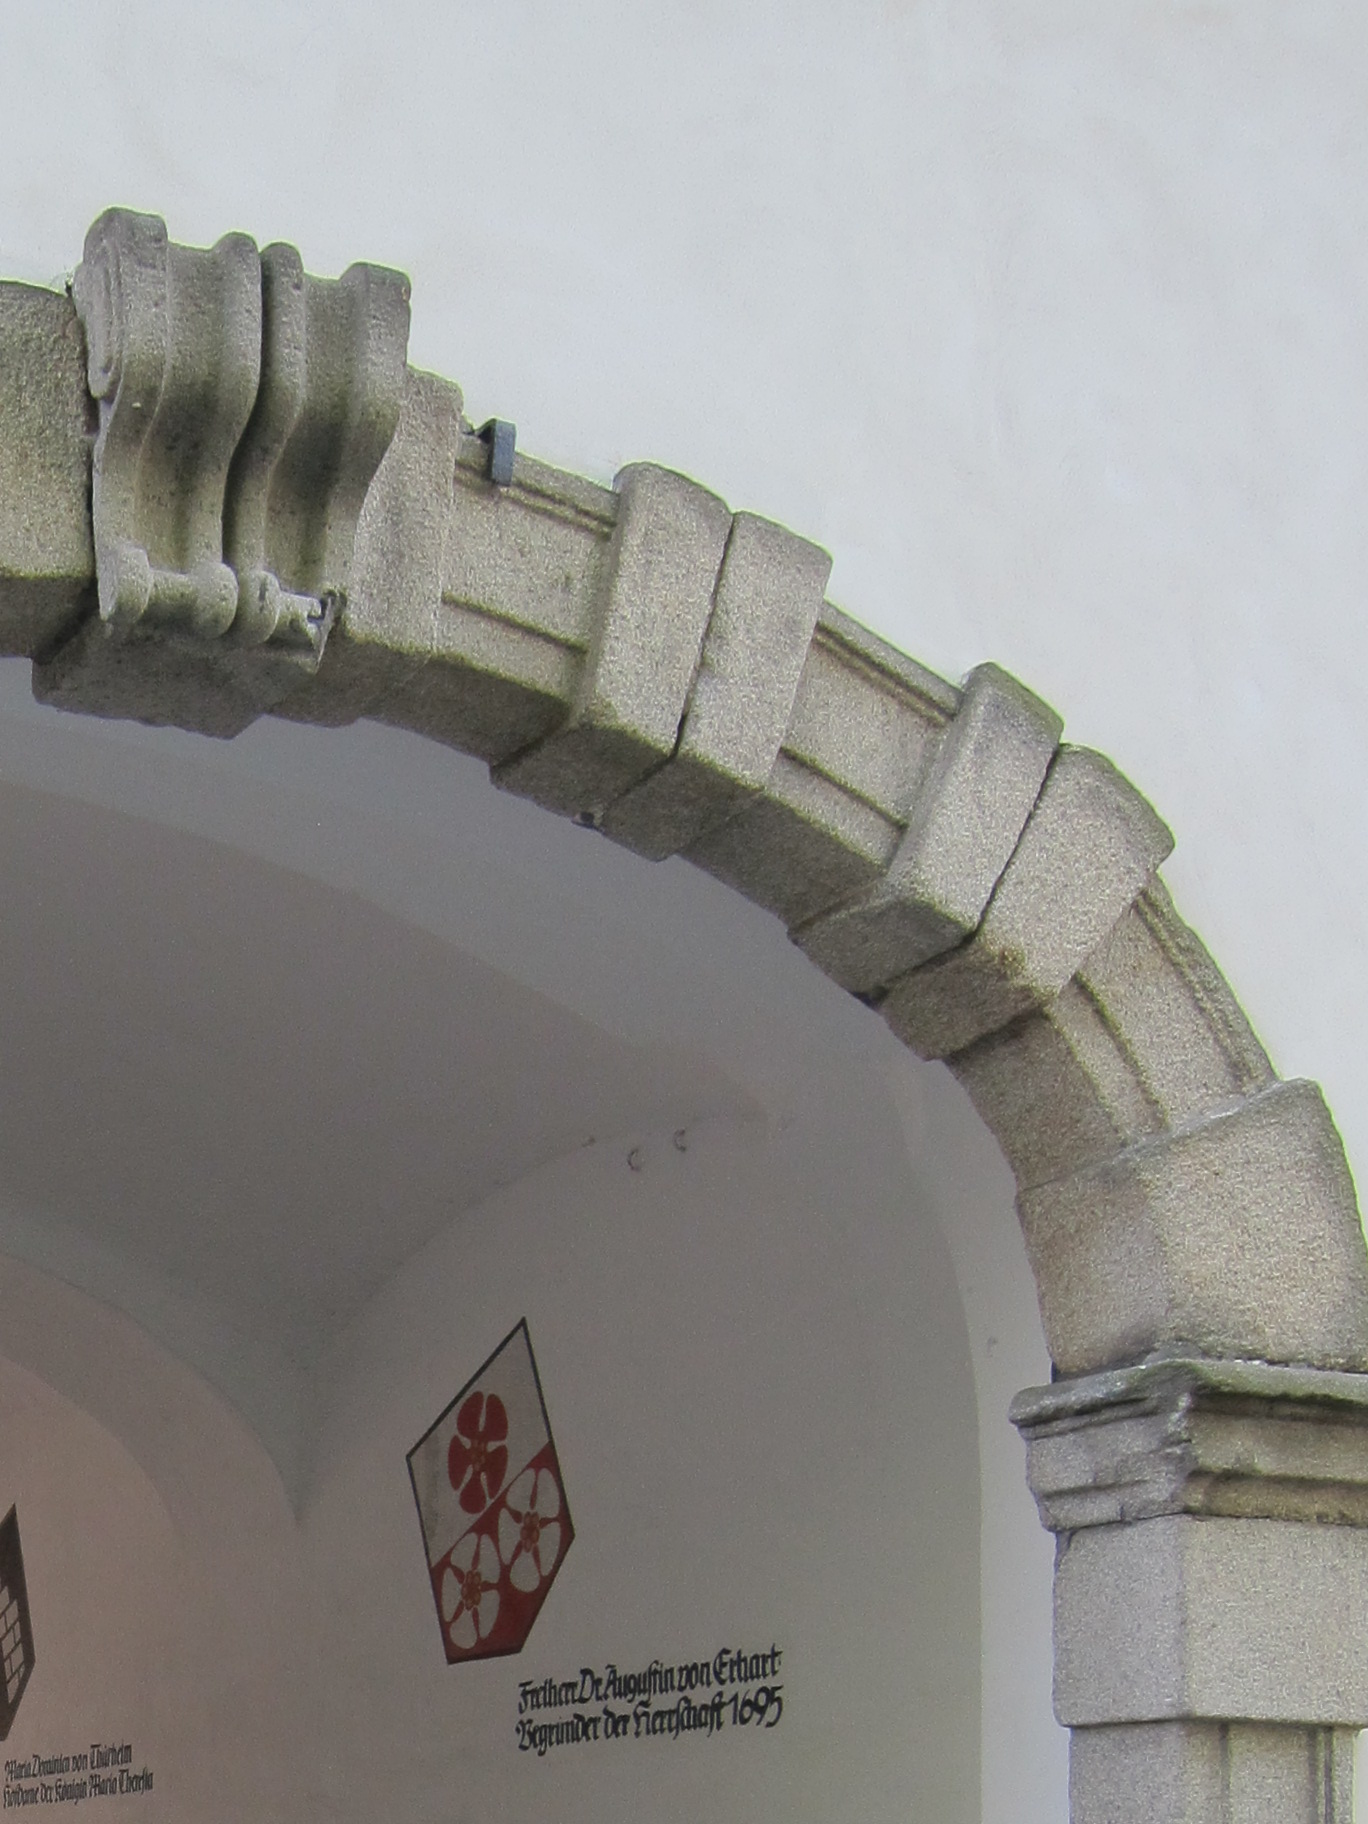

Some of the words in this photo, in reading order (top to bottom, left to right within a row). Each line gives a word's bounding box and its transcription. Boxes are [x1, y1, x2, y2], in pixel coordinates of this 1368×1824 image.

[604, 1659, 676, 1703] Augustin
[677, 1662, 712, 1692] von
[603, 1705, 630, 1739] der
[633, 1690, 726, 1740] Herrschaft
[727, 1685, 784, 1728] 1695
